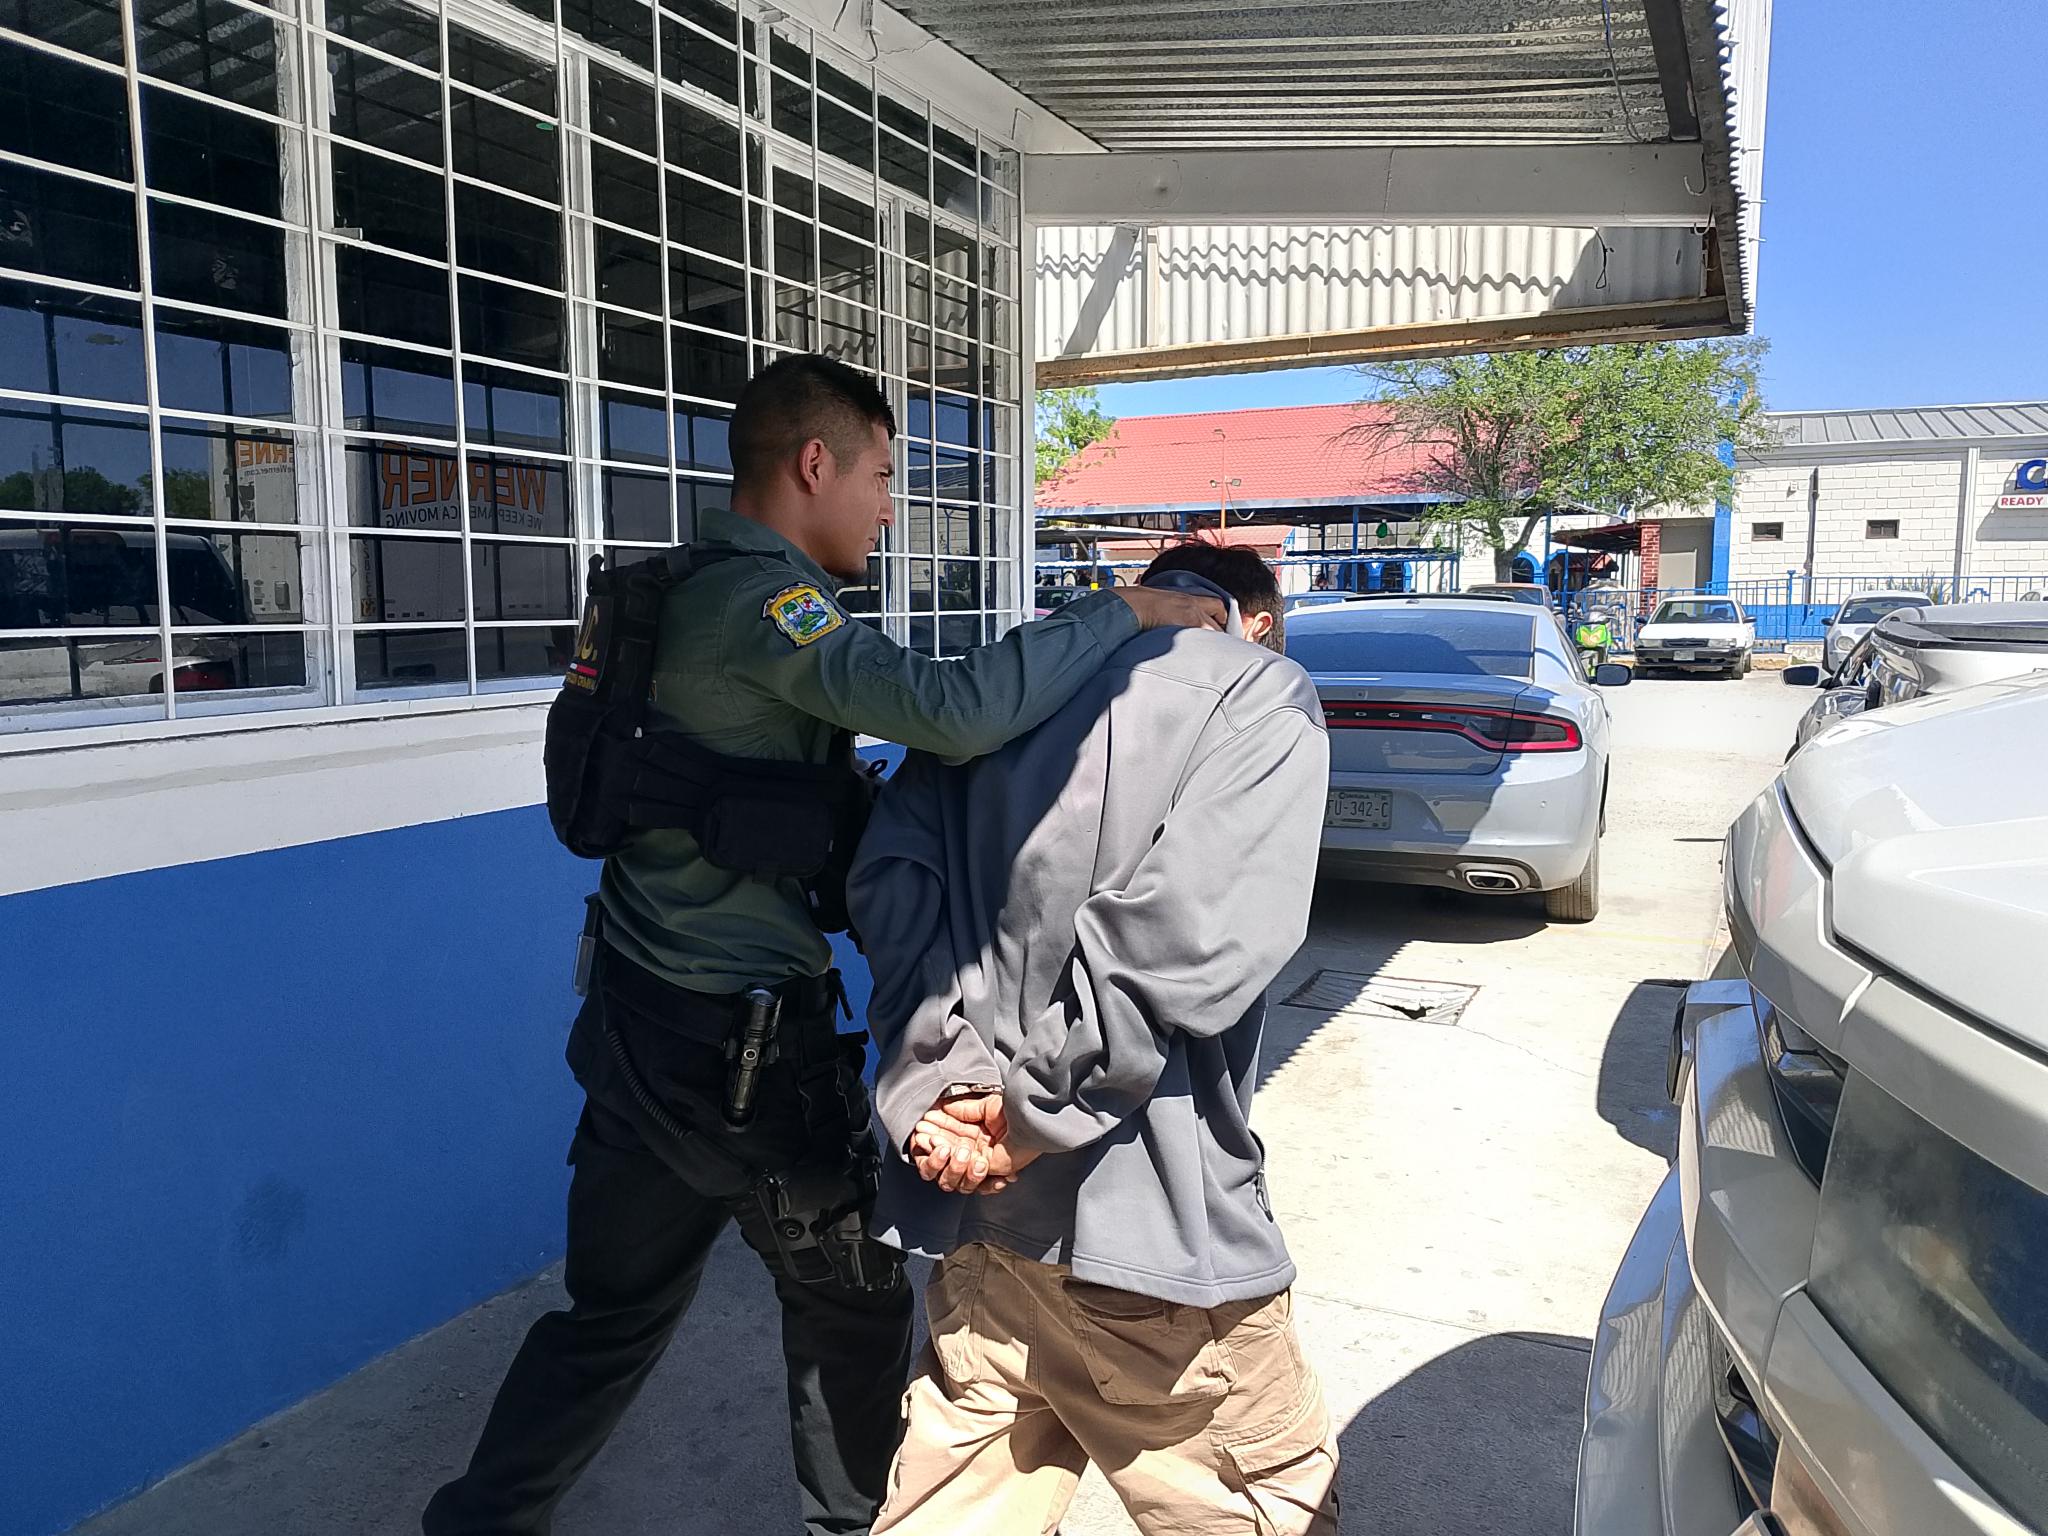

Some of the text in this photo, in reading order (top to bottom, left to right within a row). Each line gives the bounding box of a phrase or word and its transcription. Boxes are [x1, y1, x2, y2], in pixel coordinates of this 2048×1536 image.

[2017, 459, 2048, 491] C
[2001, 496, 2044, 506] READY
[1324, 710, 1433, 720] ODGE
[1325, 799, 1389, 818] FU-342-C
